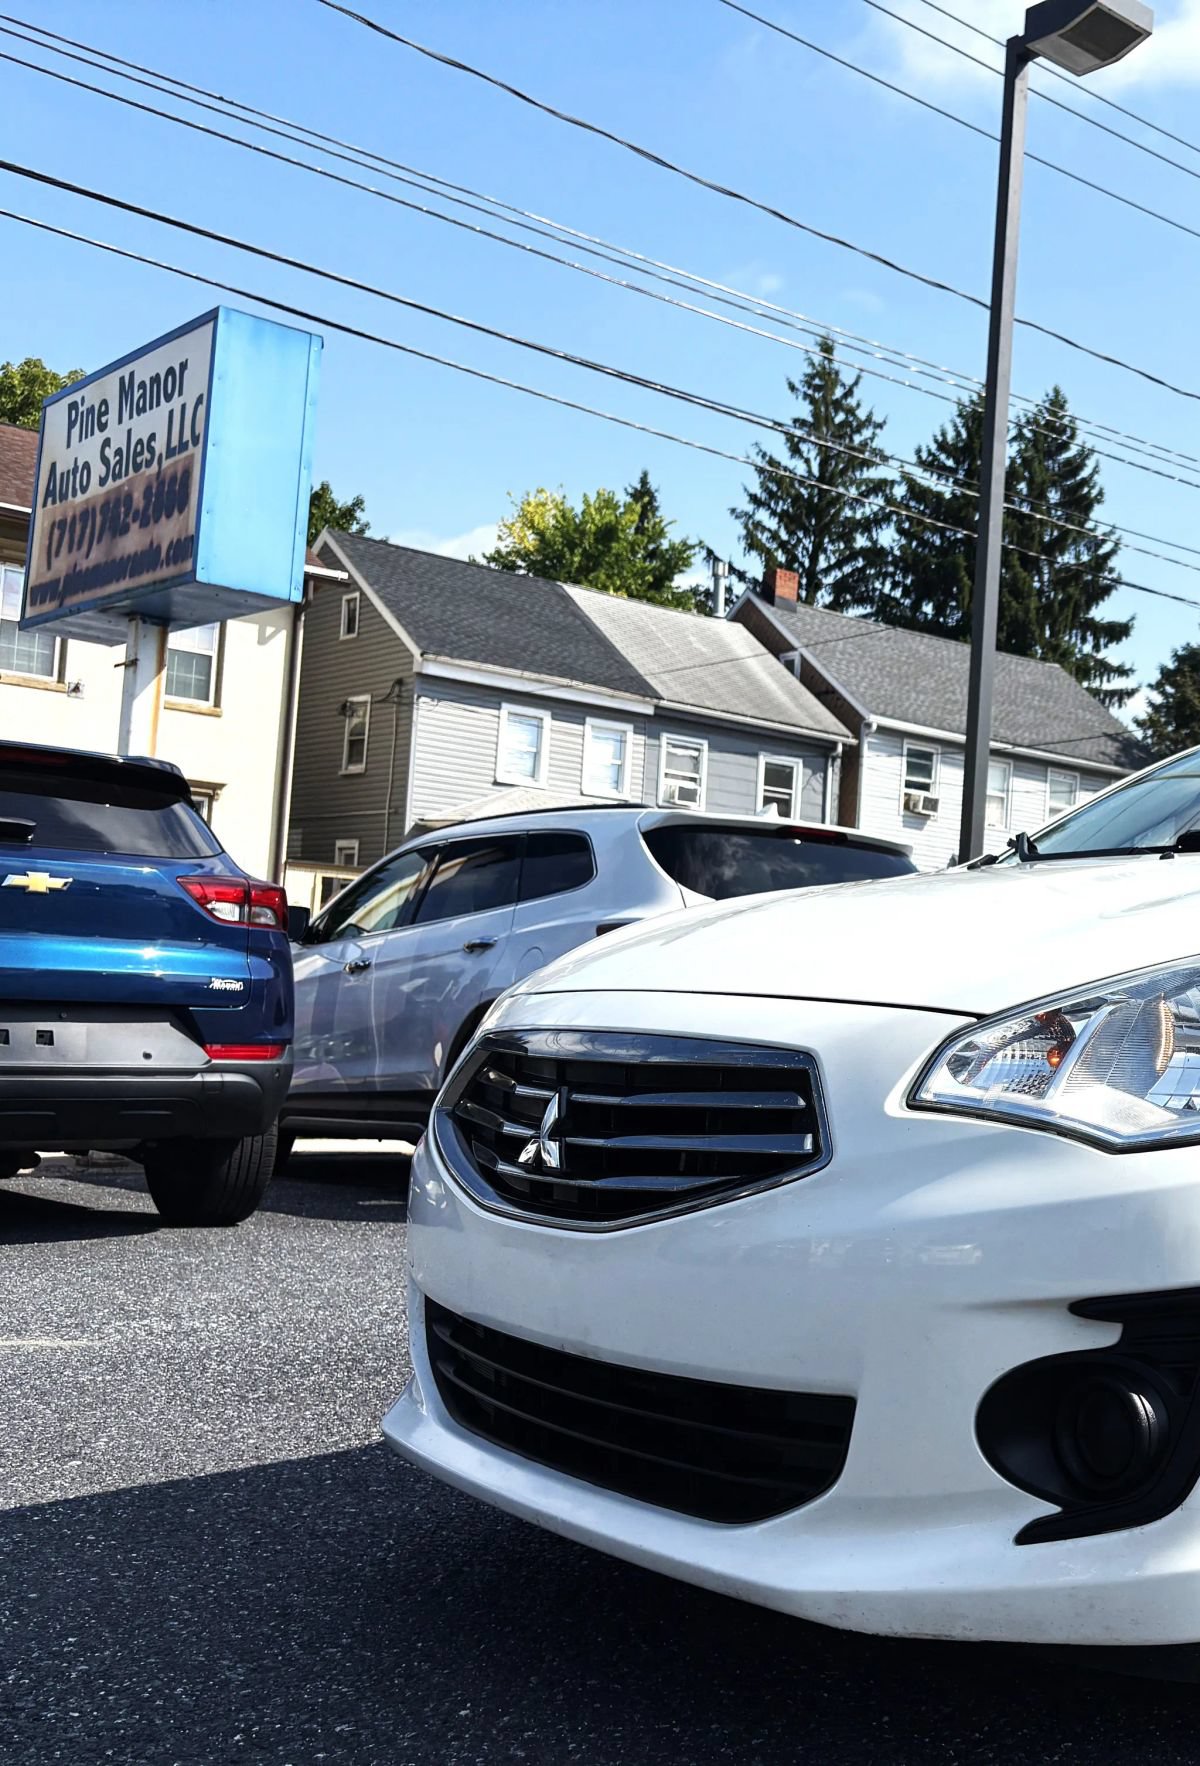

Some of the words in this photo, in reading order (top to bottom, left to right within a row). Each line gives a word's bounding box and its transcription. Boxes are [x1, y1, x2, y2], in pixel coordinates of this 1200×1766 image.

[66, 395, 110, 450] Pine
[117, 358, 189, 426] Manor
[42, 461, 92, 509] Auto
